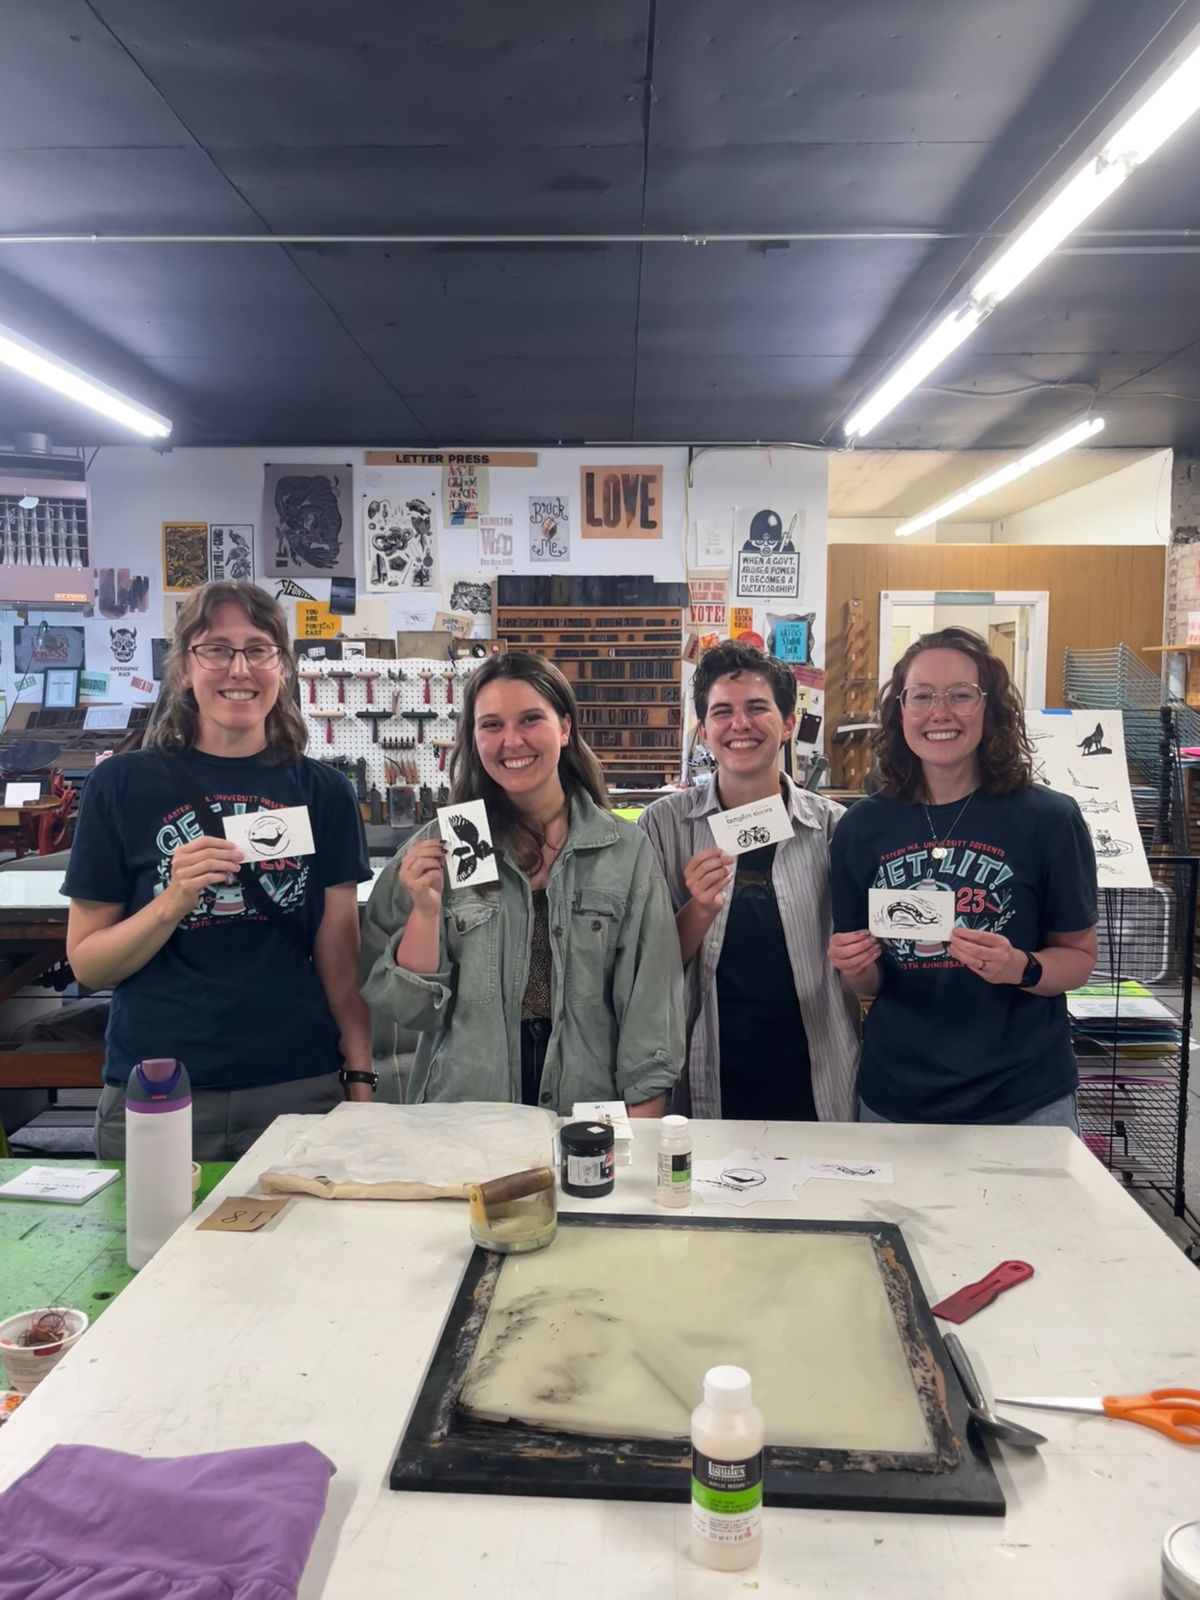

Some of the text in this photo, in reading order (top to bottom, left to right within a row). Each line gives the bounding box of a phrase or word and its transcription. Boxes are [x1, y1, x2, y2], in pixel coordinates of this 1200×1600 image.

[396, 455, 489, 463] LETTER PRESS
[586, 472, 657, 529] LOVE
[743, 557, 796, 565] WHEN A GOVT.
[741, 566, 796, 575] ABUSES POWER
[741, 575, 793, 584] IT BECOMES A
[741, 584, 796, 593] DICTATORSHIP!
[690, 605, 726, 622] VOTE!
[163, 803, 193, 824] EASTER
[880, 847, 906, 861] ASTERN
[969, 841, 1005, 858] PRESENTS
[939, 847, 1014, 890] LIT!
[956, 887, 986, 913] 23
[708, 1461, 746, 1478] Liquitex
